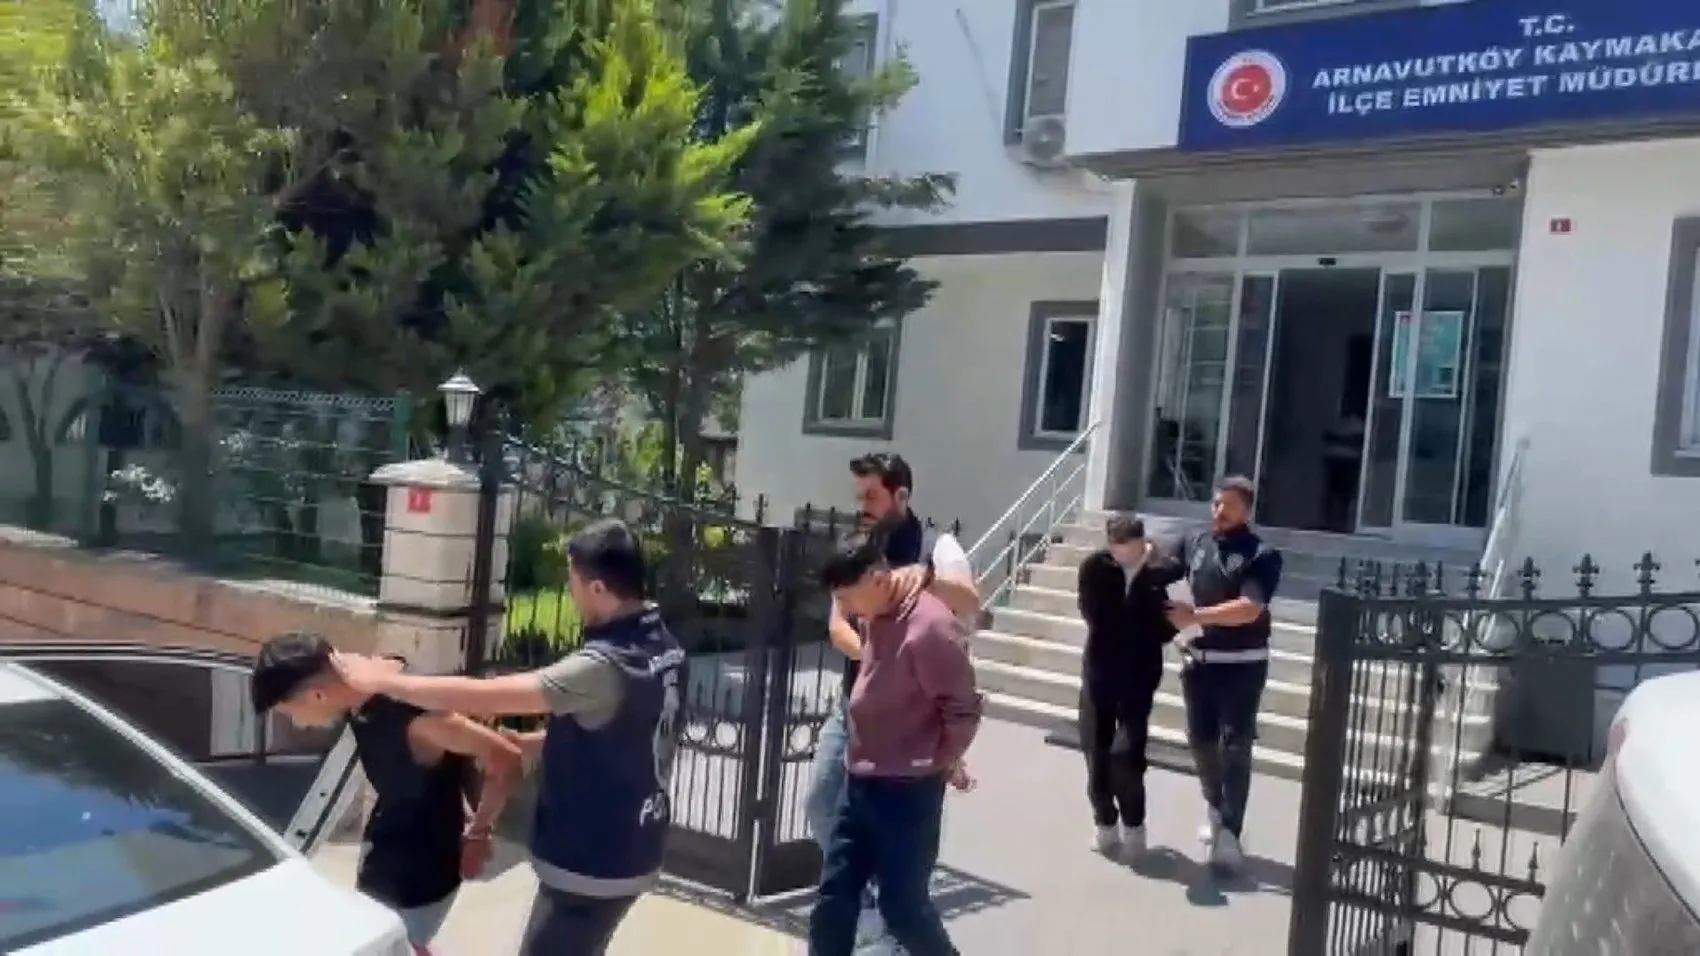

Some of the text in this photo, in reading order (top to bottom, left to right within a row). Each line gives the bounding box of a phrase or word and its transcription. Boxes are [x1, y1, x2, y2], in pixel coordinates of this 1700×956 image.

[1518, 14, 1575, 36] T.C.
[1312, 46, 1523, 88] ARNAVUTKÖY
[1328, 91, 1394, 115] İLÇE
[1403, 76, 1548, 107] EMNİYET
